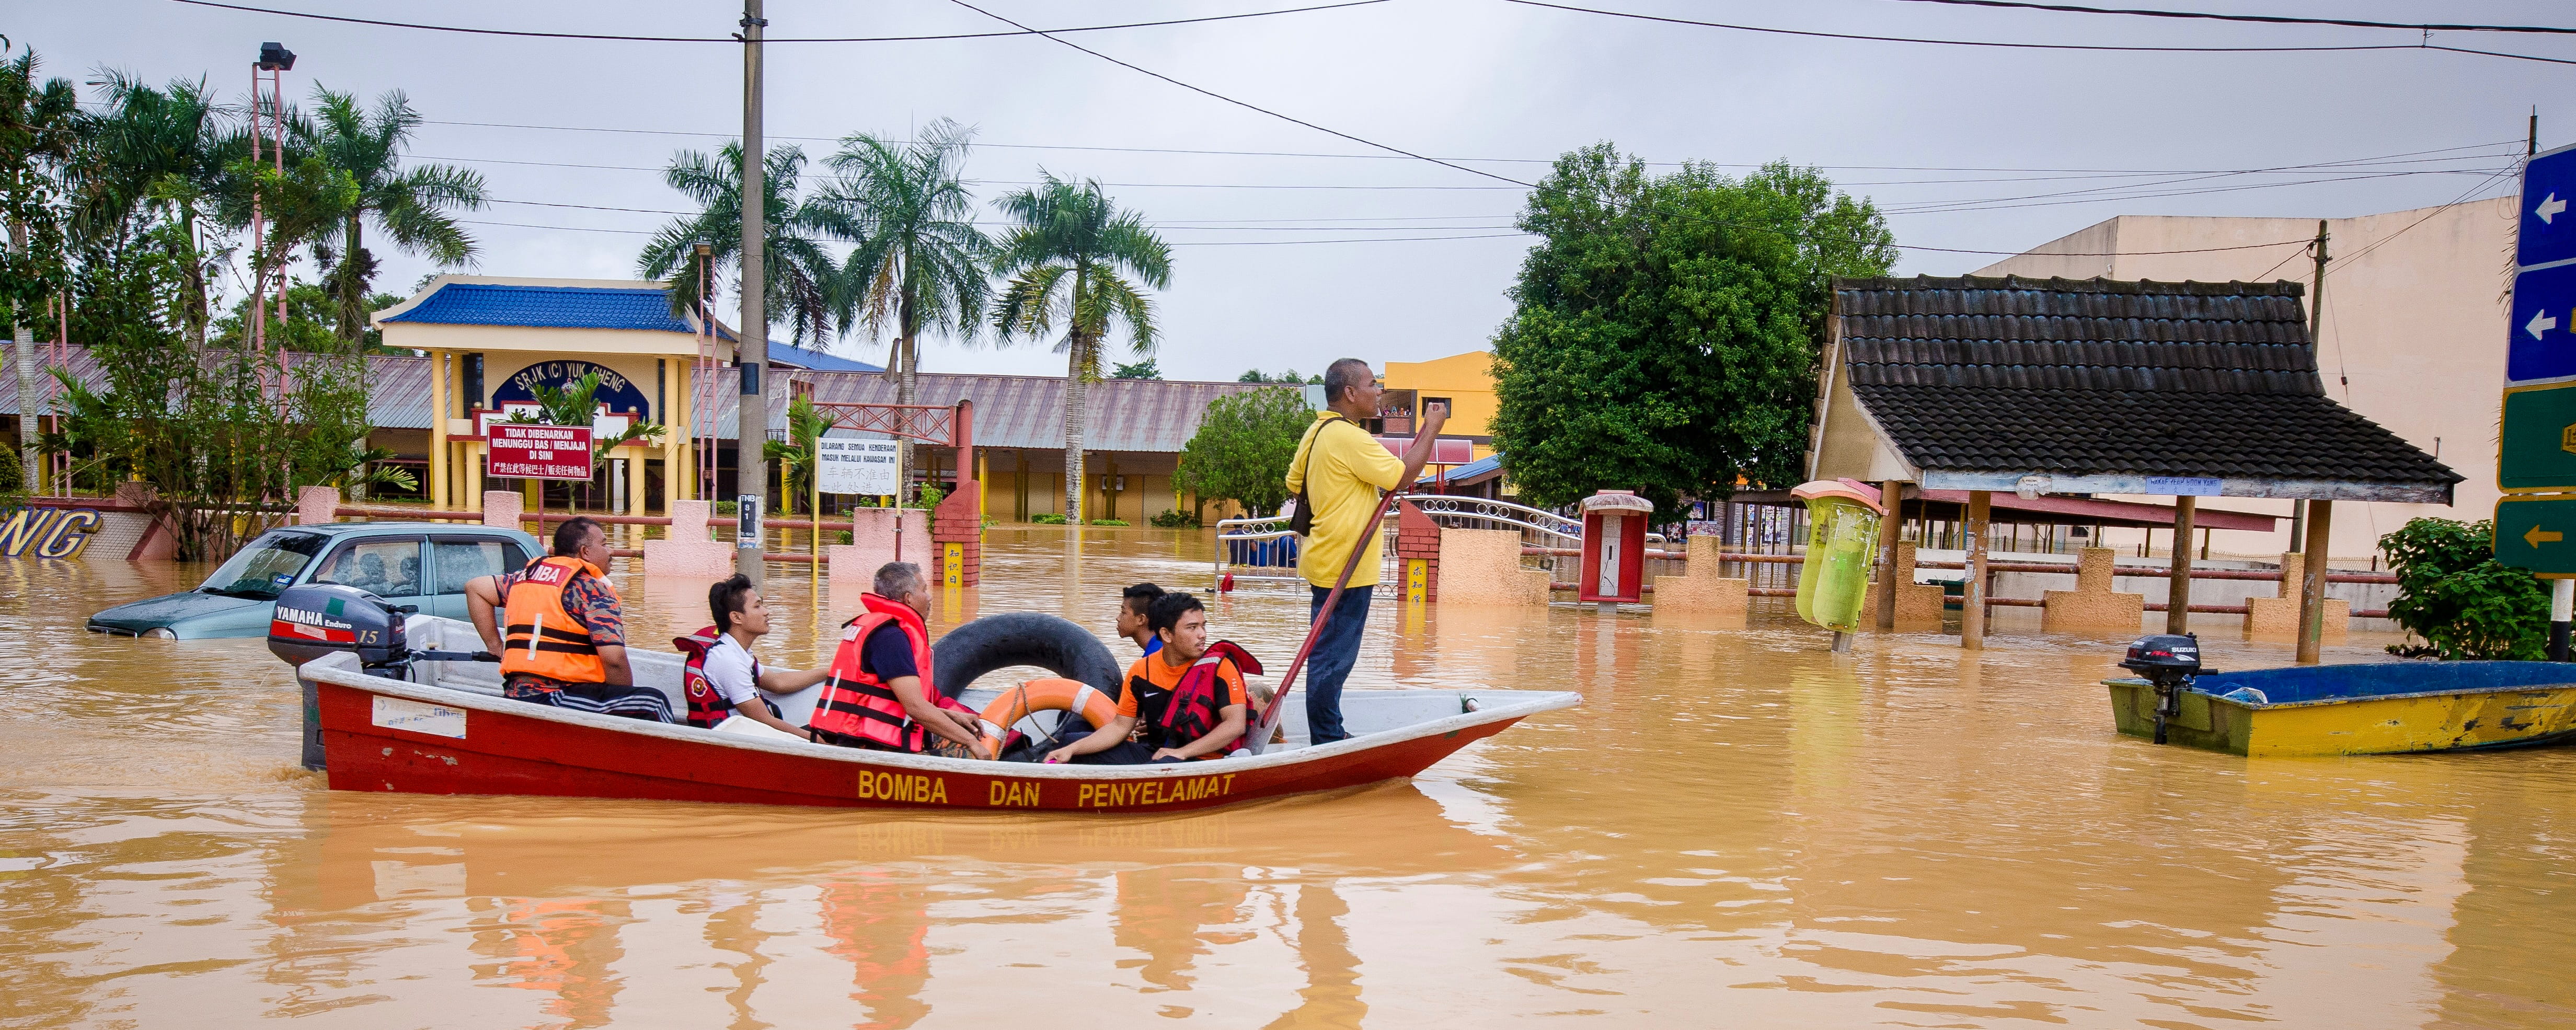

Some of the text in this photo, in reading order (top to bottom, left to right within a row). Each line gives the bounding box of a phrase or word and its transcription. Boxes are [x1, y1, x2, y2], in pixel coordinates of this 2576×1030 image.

[515, 366, 546, 390] SRJK
[548, 363, 561, 378] (C)
[567, 363, 585, 378] YUK
[505, 429, 573, 439] TIDAK DIBENARKAN
[492, 438, 533, 449] MENUNGGU
[535, 440, 549, 449] BAS
[554, 441, 586, 450] MENJAJA
[529, 450, 553, 460] DI SINI
[0, 506, 101, 559] NG
[516, 564, 561, 582] BMBA
[277, 606, 352, 629] YAMAHA Enduro
[359, 630, 379, 644] 15
[858, 770, 1236, 807] BOMBA DAN PENYELAMAT
